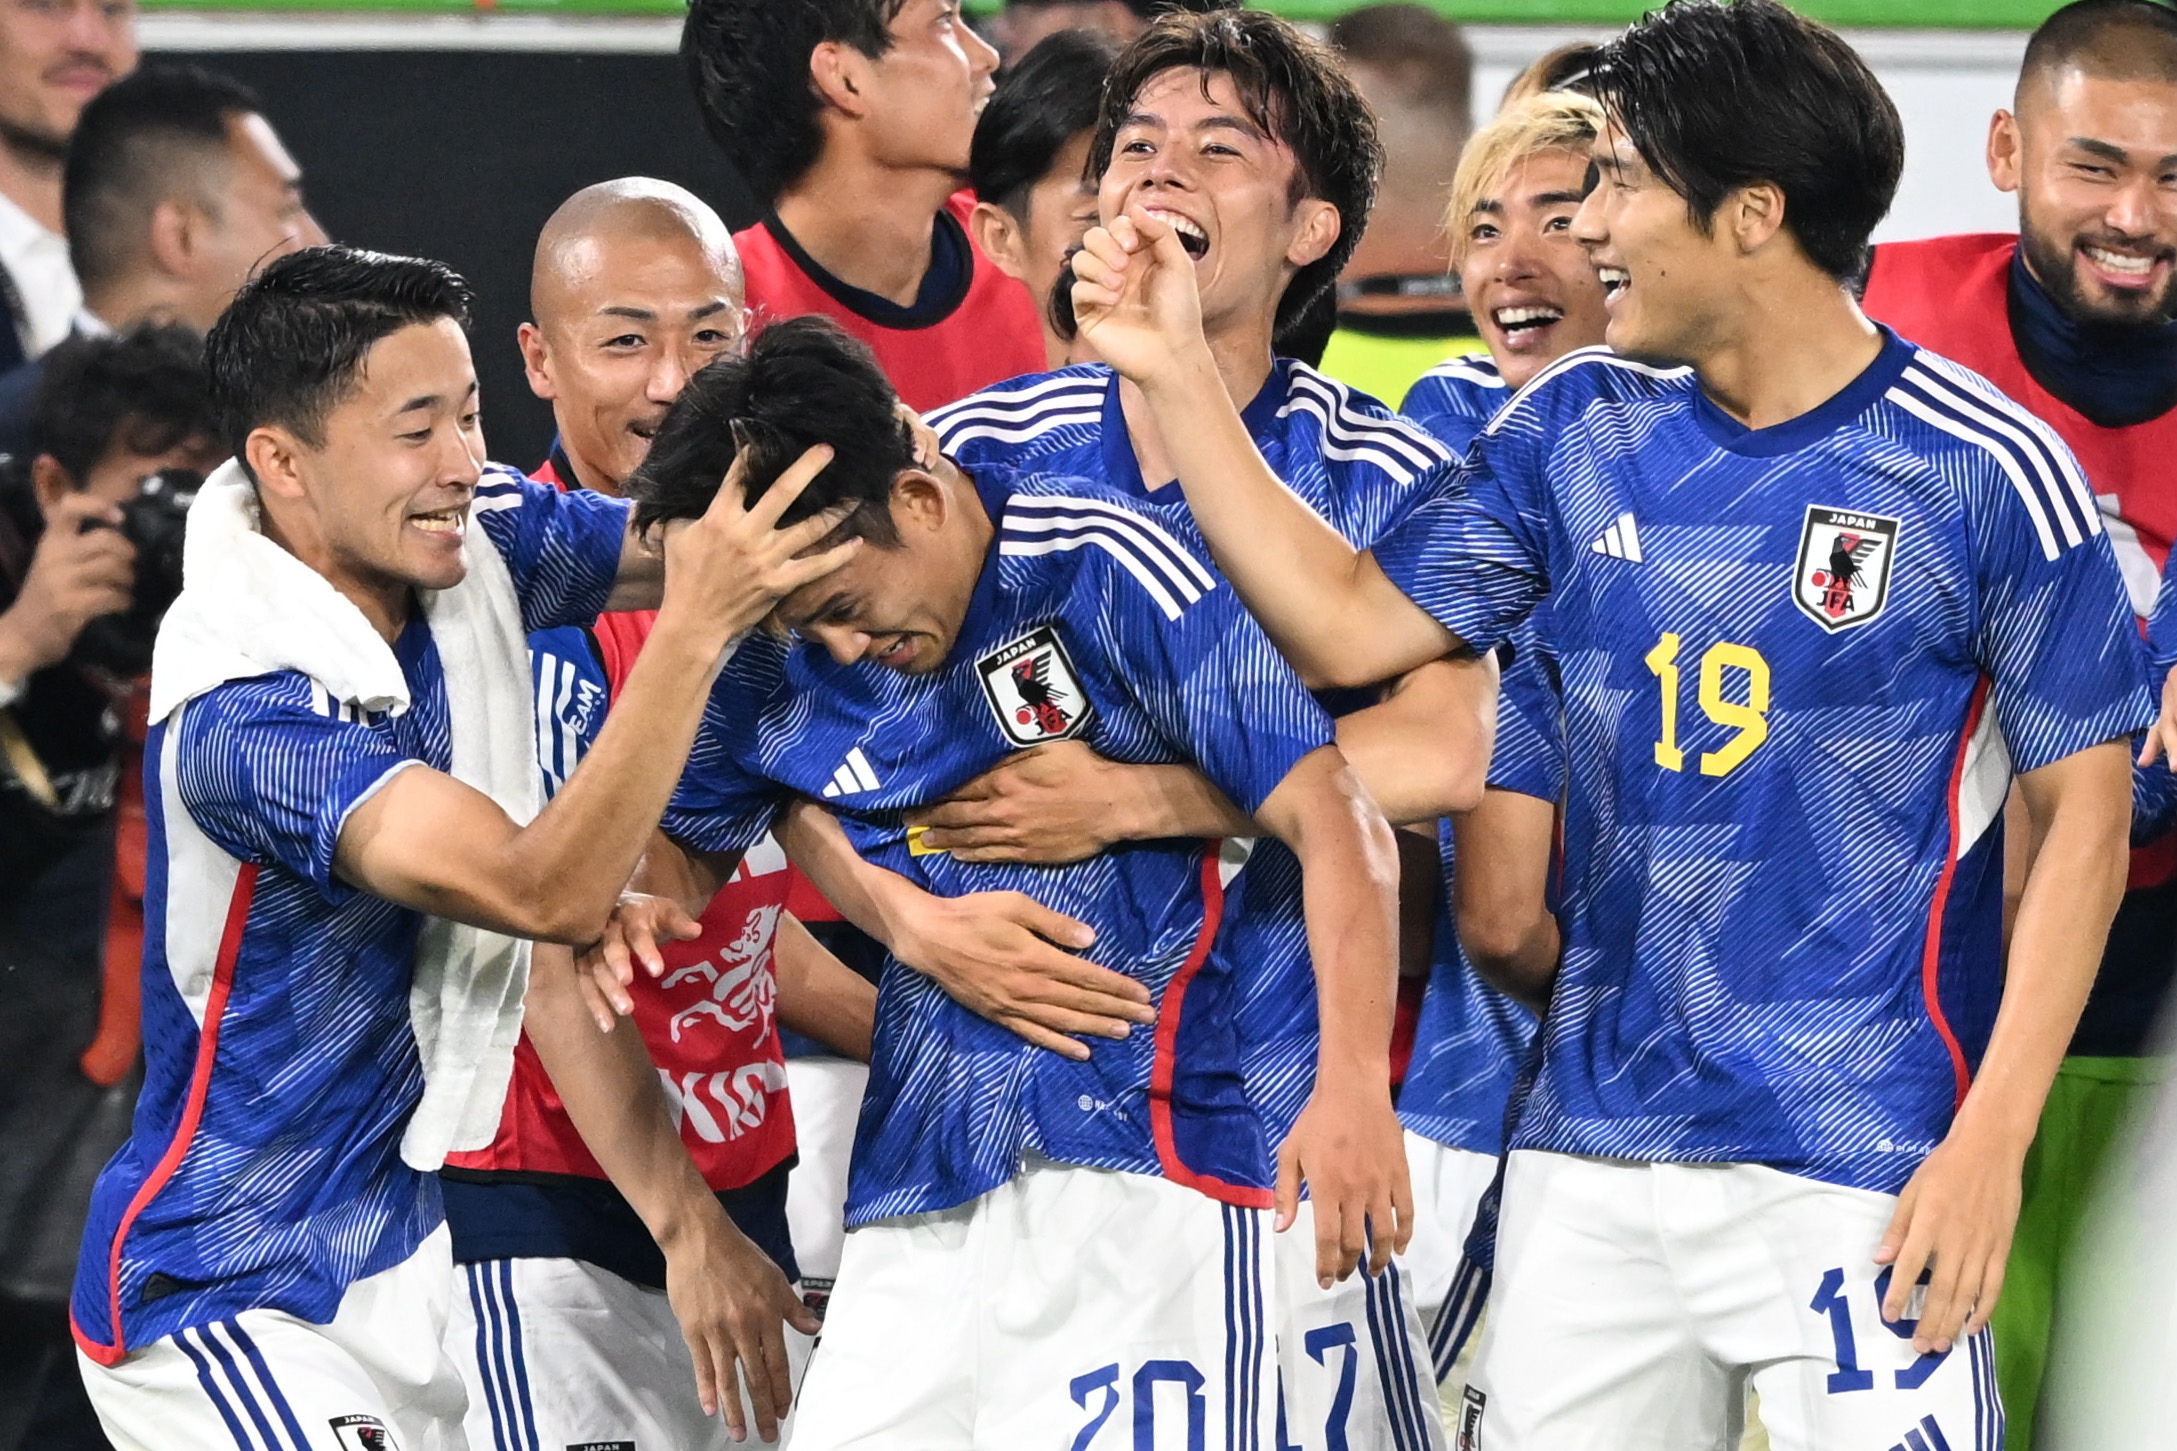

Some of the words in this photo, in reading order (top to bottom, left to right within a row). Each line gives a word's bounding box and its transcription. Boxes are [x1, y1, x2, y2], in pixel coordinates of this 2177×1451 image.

[1829, 513, 1876, 530] JAPAN
[1816, 589, 1855, 612] JFA
[996, 637, 1037, 665] JAPAN
[569, 679, 602, 735] EAM
[1644, 632, 1770, 777] 19
[1070, 1360, 1205, 1451] 20
[583, 1443, 620, 1451] JAPAN
